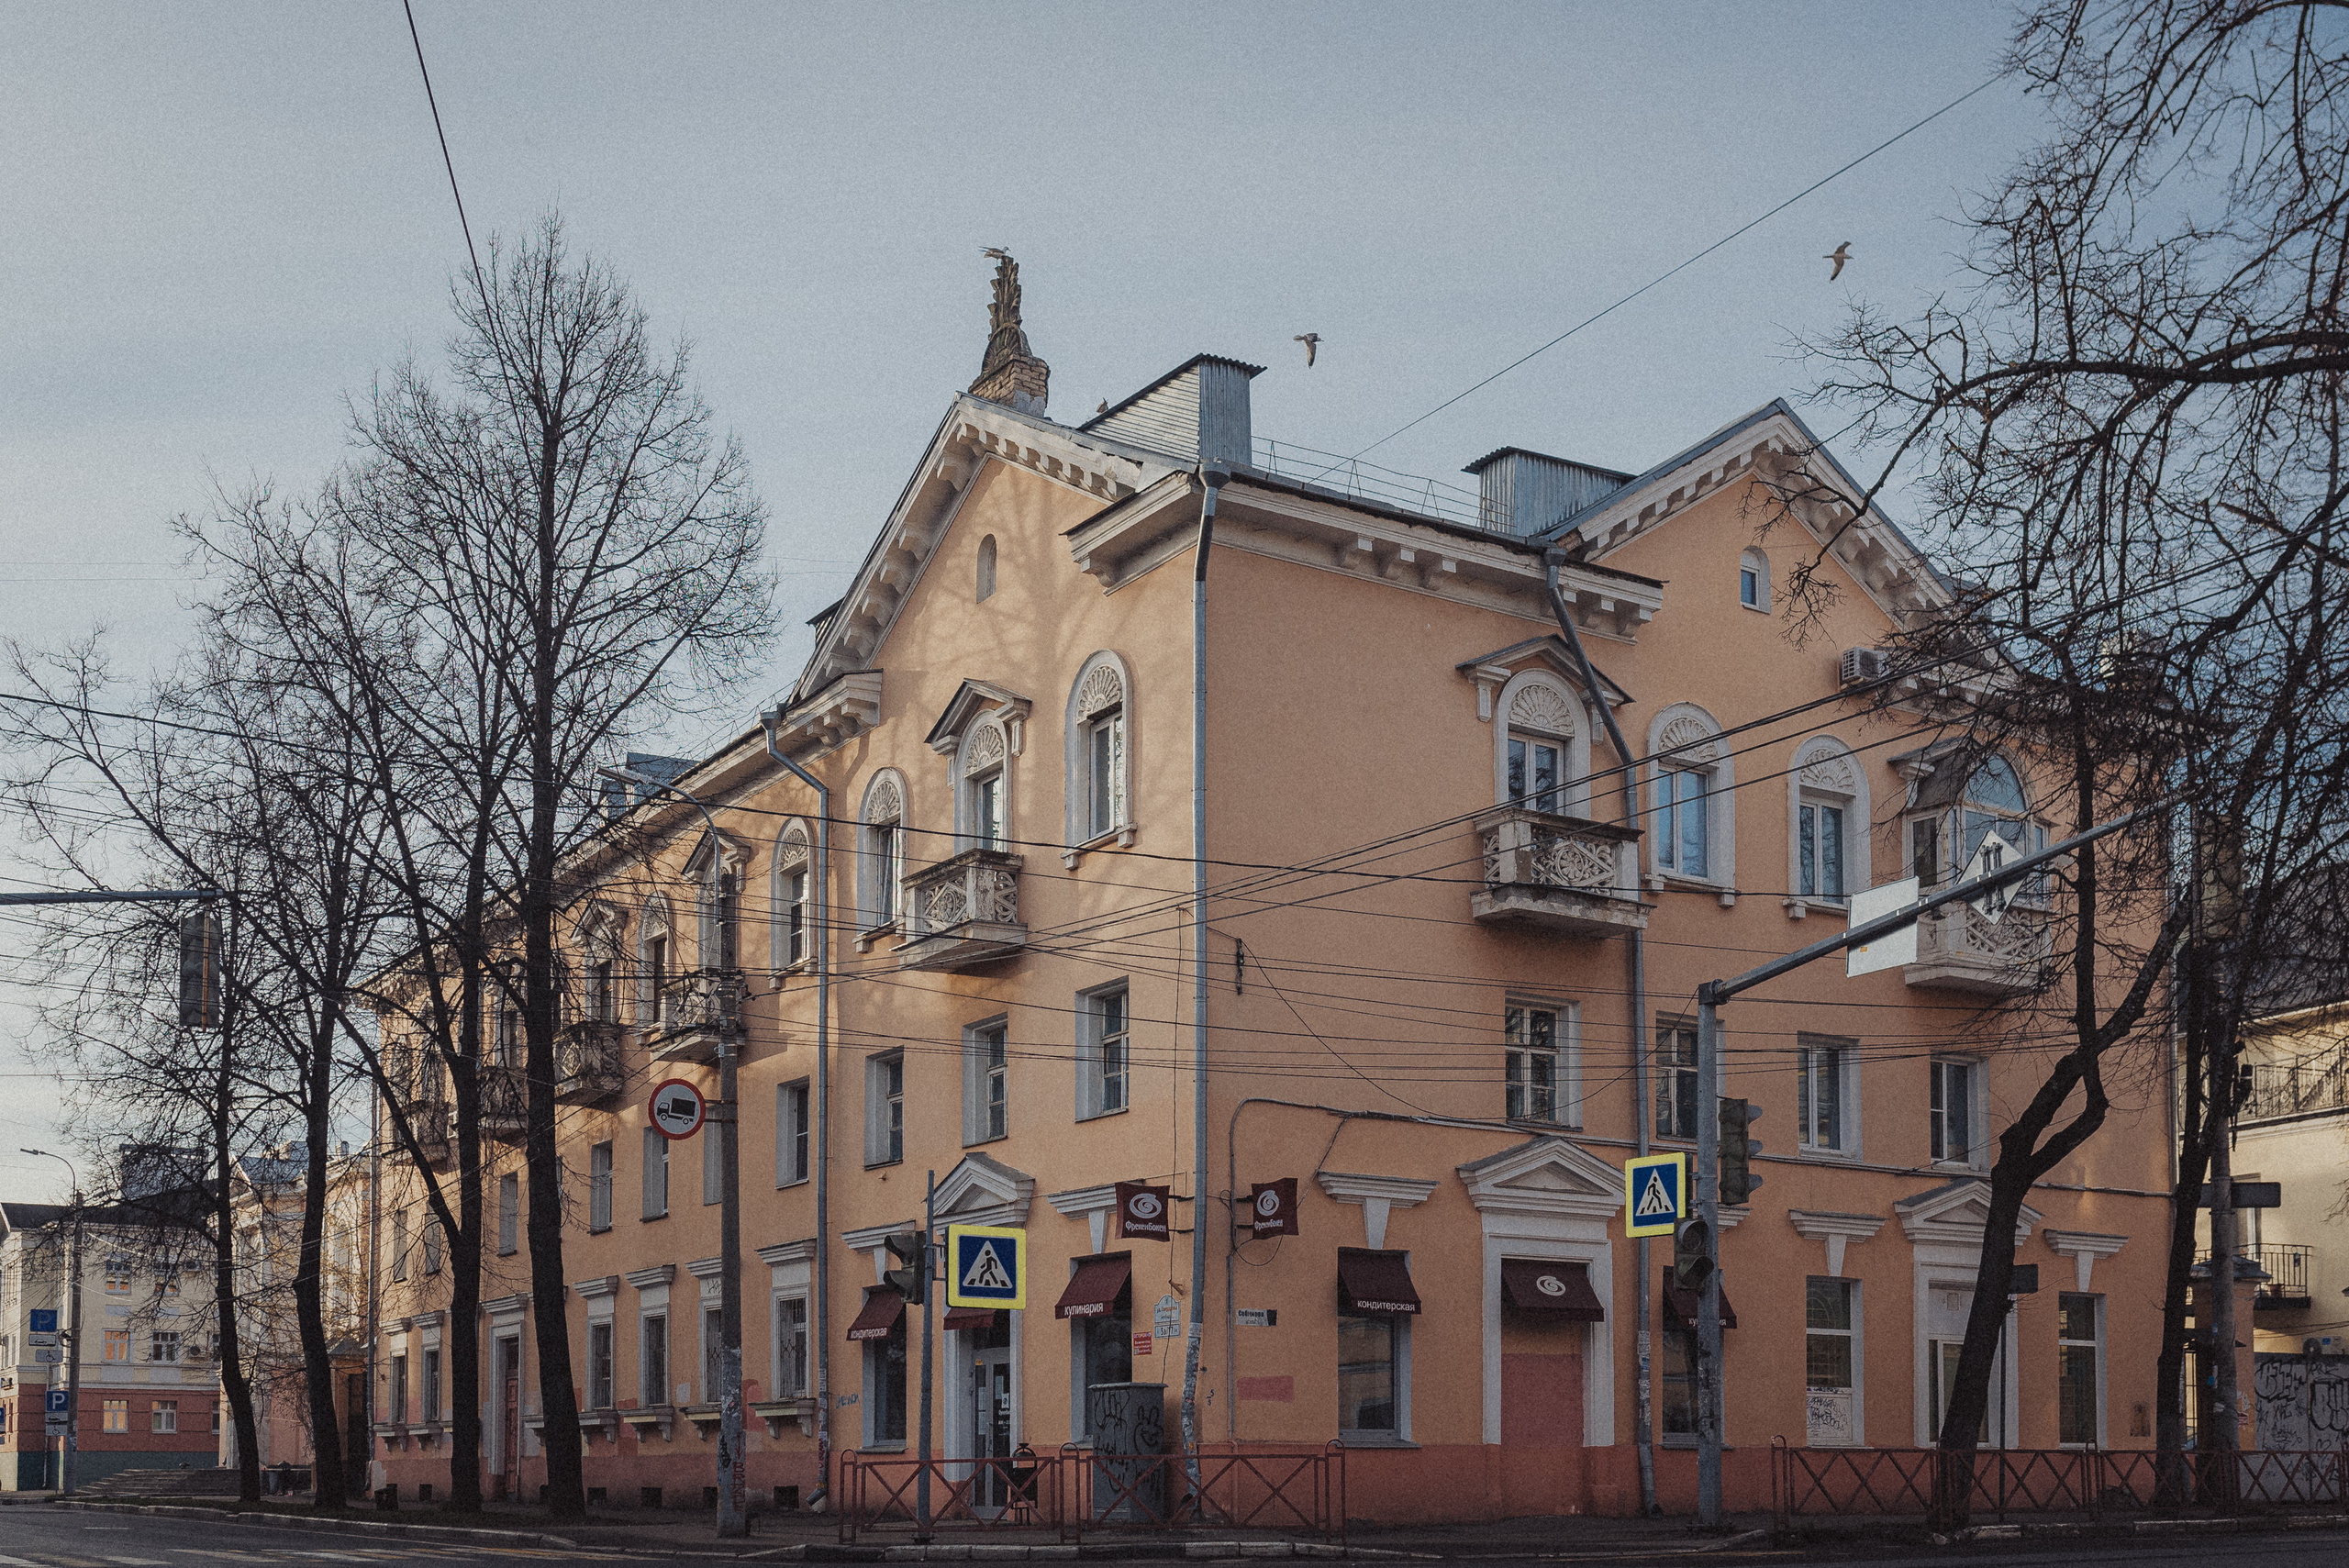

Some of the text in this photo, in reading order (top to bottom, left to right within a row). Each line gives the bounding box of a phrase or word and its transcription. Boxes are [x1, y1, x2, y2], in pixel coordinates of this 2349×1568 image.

[1064, 1303, 1104, 1318] кулинария
[1357, 1300, 1415, 1312] кондитерская
[52, 1393, 65, 1409] P
